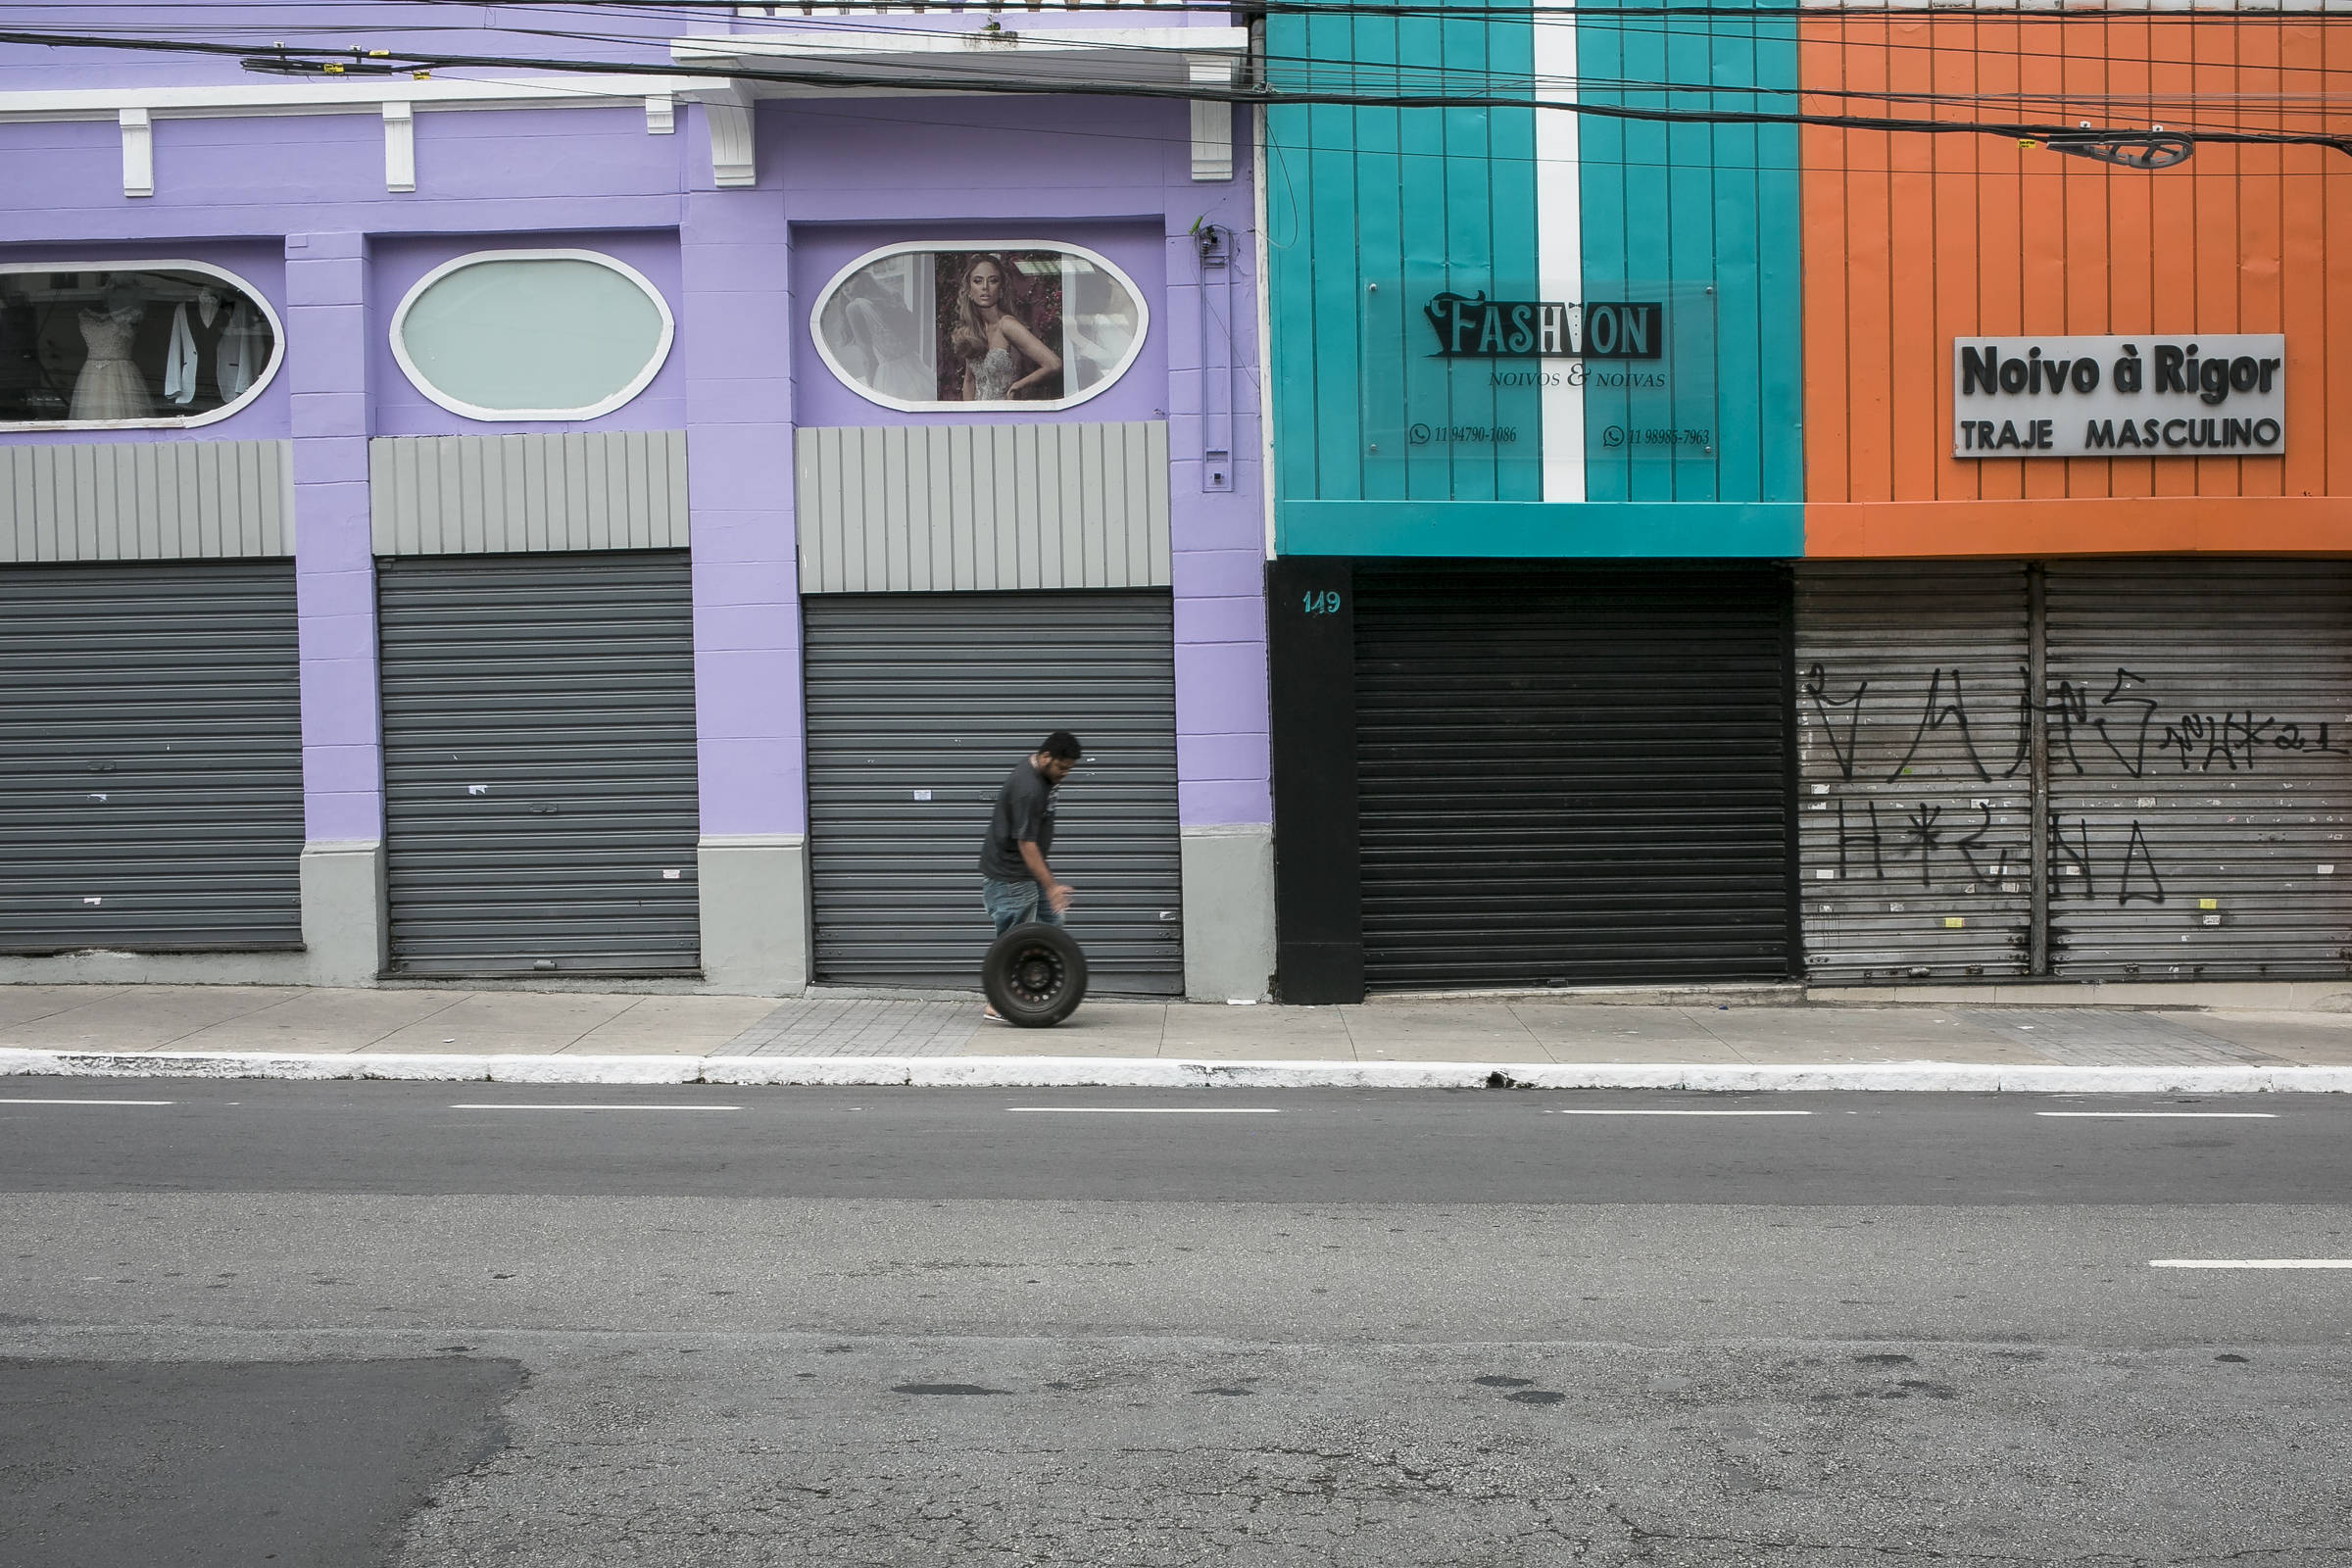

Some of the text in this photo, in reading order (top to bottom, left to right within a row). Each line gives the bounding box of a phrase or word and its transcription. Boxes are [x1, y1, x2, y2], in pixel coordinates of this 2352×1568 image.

[1429, 290, 1649, 354] FASHION
[1488, 363, 1666, 387] NOIVOS & NOIVAS
[1961, 343, 2281, 405] Noivo à Rigor
[1961, 417, 2281, 450] TRAJE MASCULINO
[1302, 590, 1341, 614] 149
